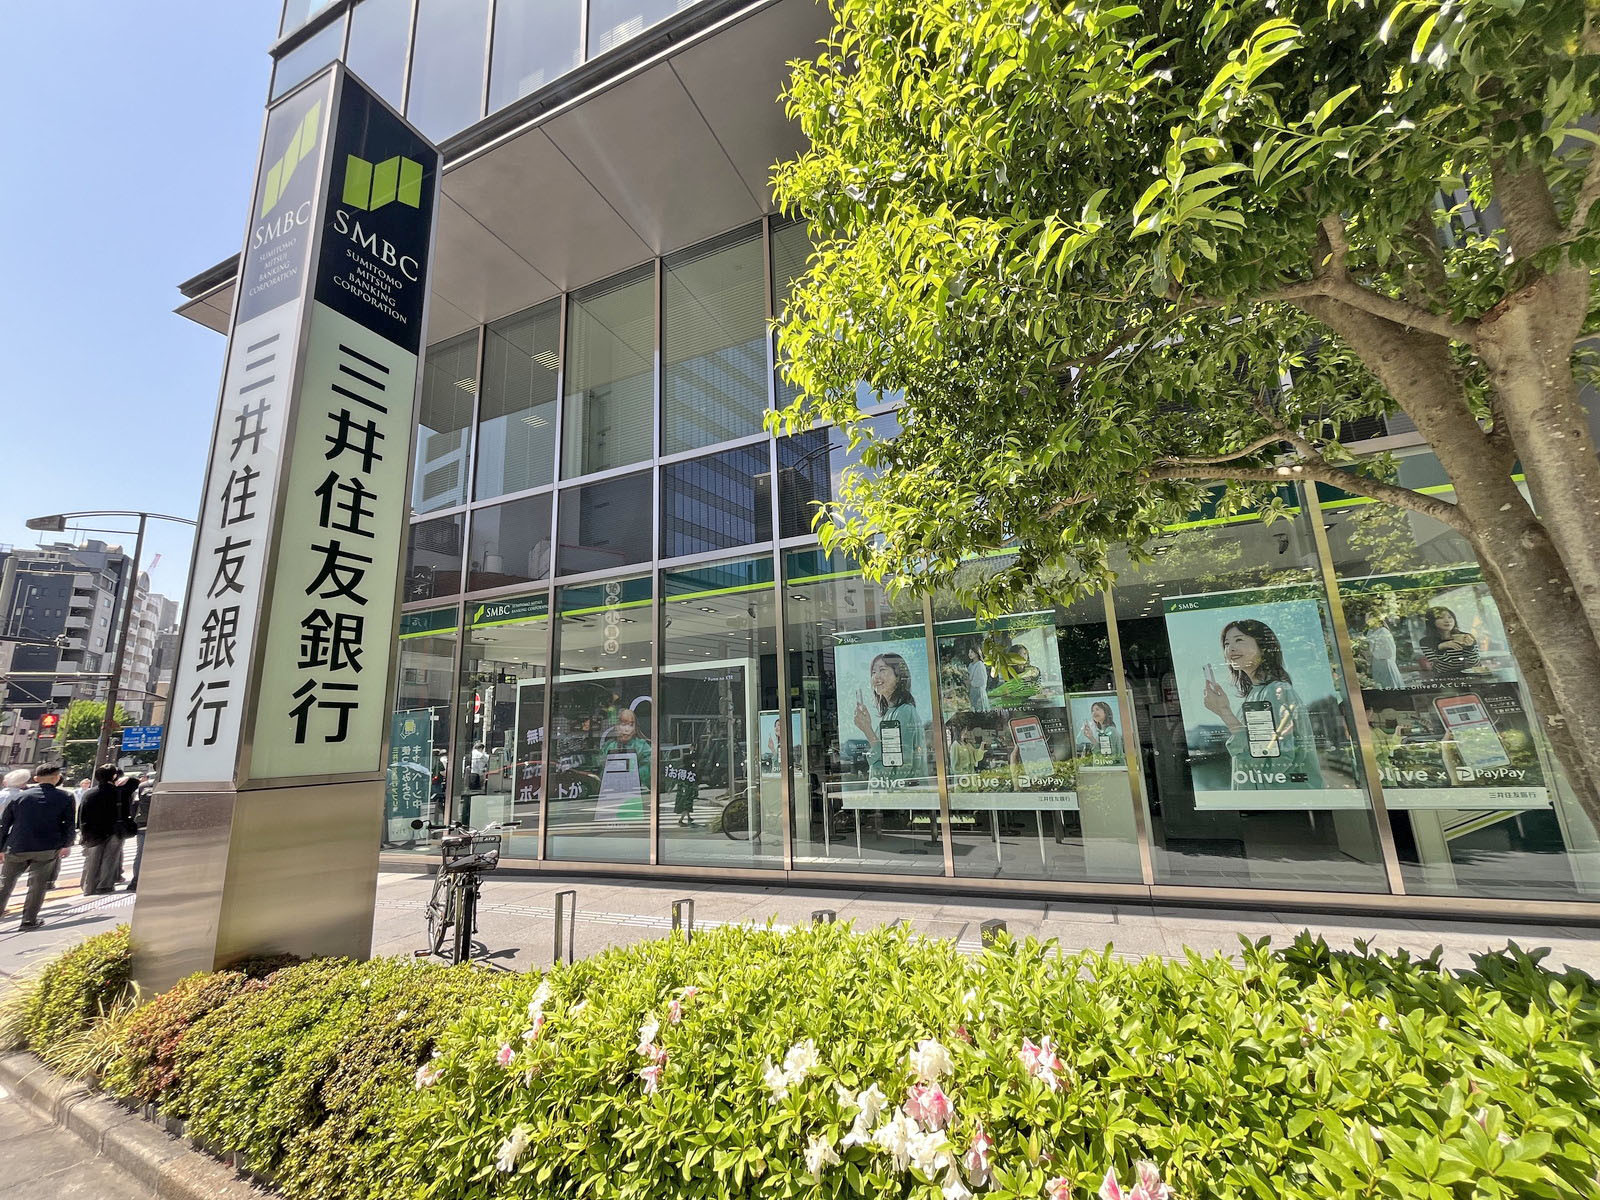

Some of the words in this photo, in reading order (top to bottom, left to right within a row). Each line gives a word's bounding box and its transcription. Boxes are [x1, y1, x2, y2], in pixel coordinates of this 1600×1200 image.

[253, 201, 310, 250] SMBC
[260, 238, 297, 261] SUMITOMO
[334, 210, 419, 282] SMBC
[259, 261, 290, 281] BANKING
[264, 252, 288, 269] MITSUI
[346, 248, 403, 289] SUMITOMO
[249, 266, 298, 296] CORPORATION
[349, 273, 396, 307] BANKING
[356, 267, 391, 293] MITSUI
[333, 275, 407, 324] CORPORATION
[186, 333, 280, 748] 三井住友銀行
[288, 344, 390, 745] 三井住友銀行
[486, 605, 510, 617] SMBC
[870, 776, 905, 789] Olive
[959, 775, 999, 787] Olive
[1032, 777, 1064, 786] PayPay
[1233, 769, 1287, 784] Olive
[1476, 768, 1525, 781] PayPay
[520, 782, 583, 801] ポイトが
